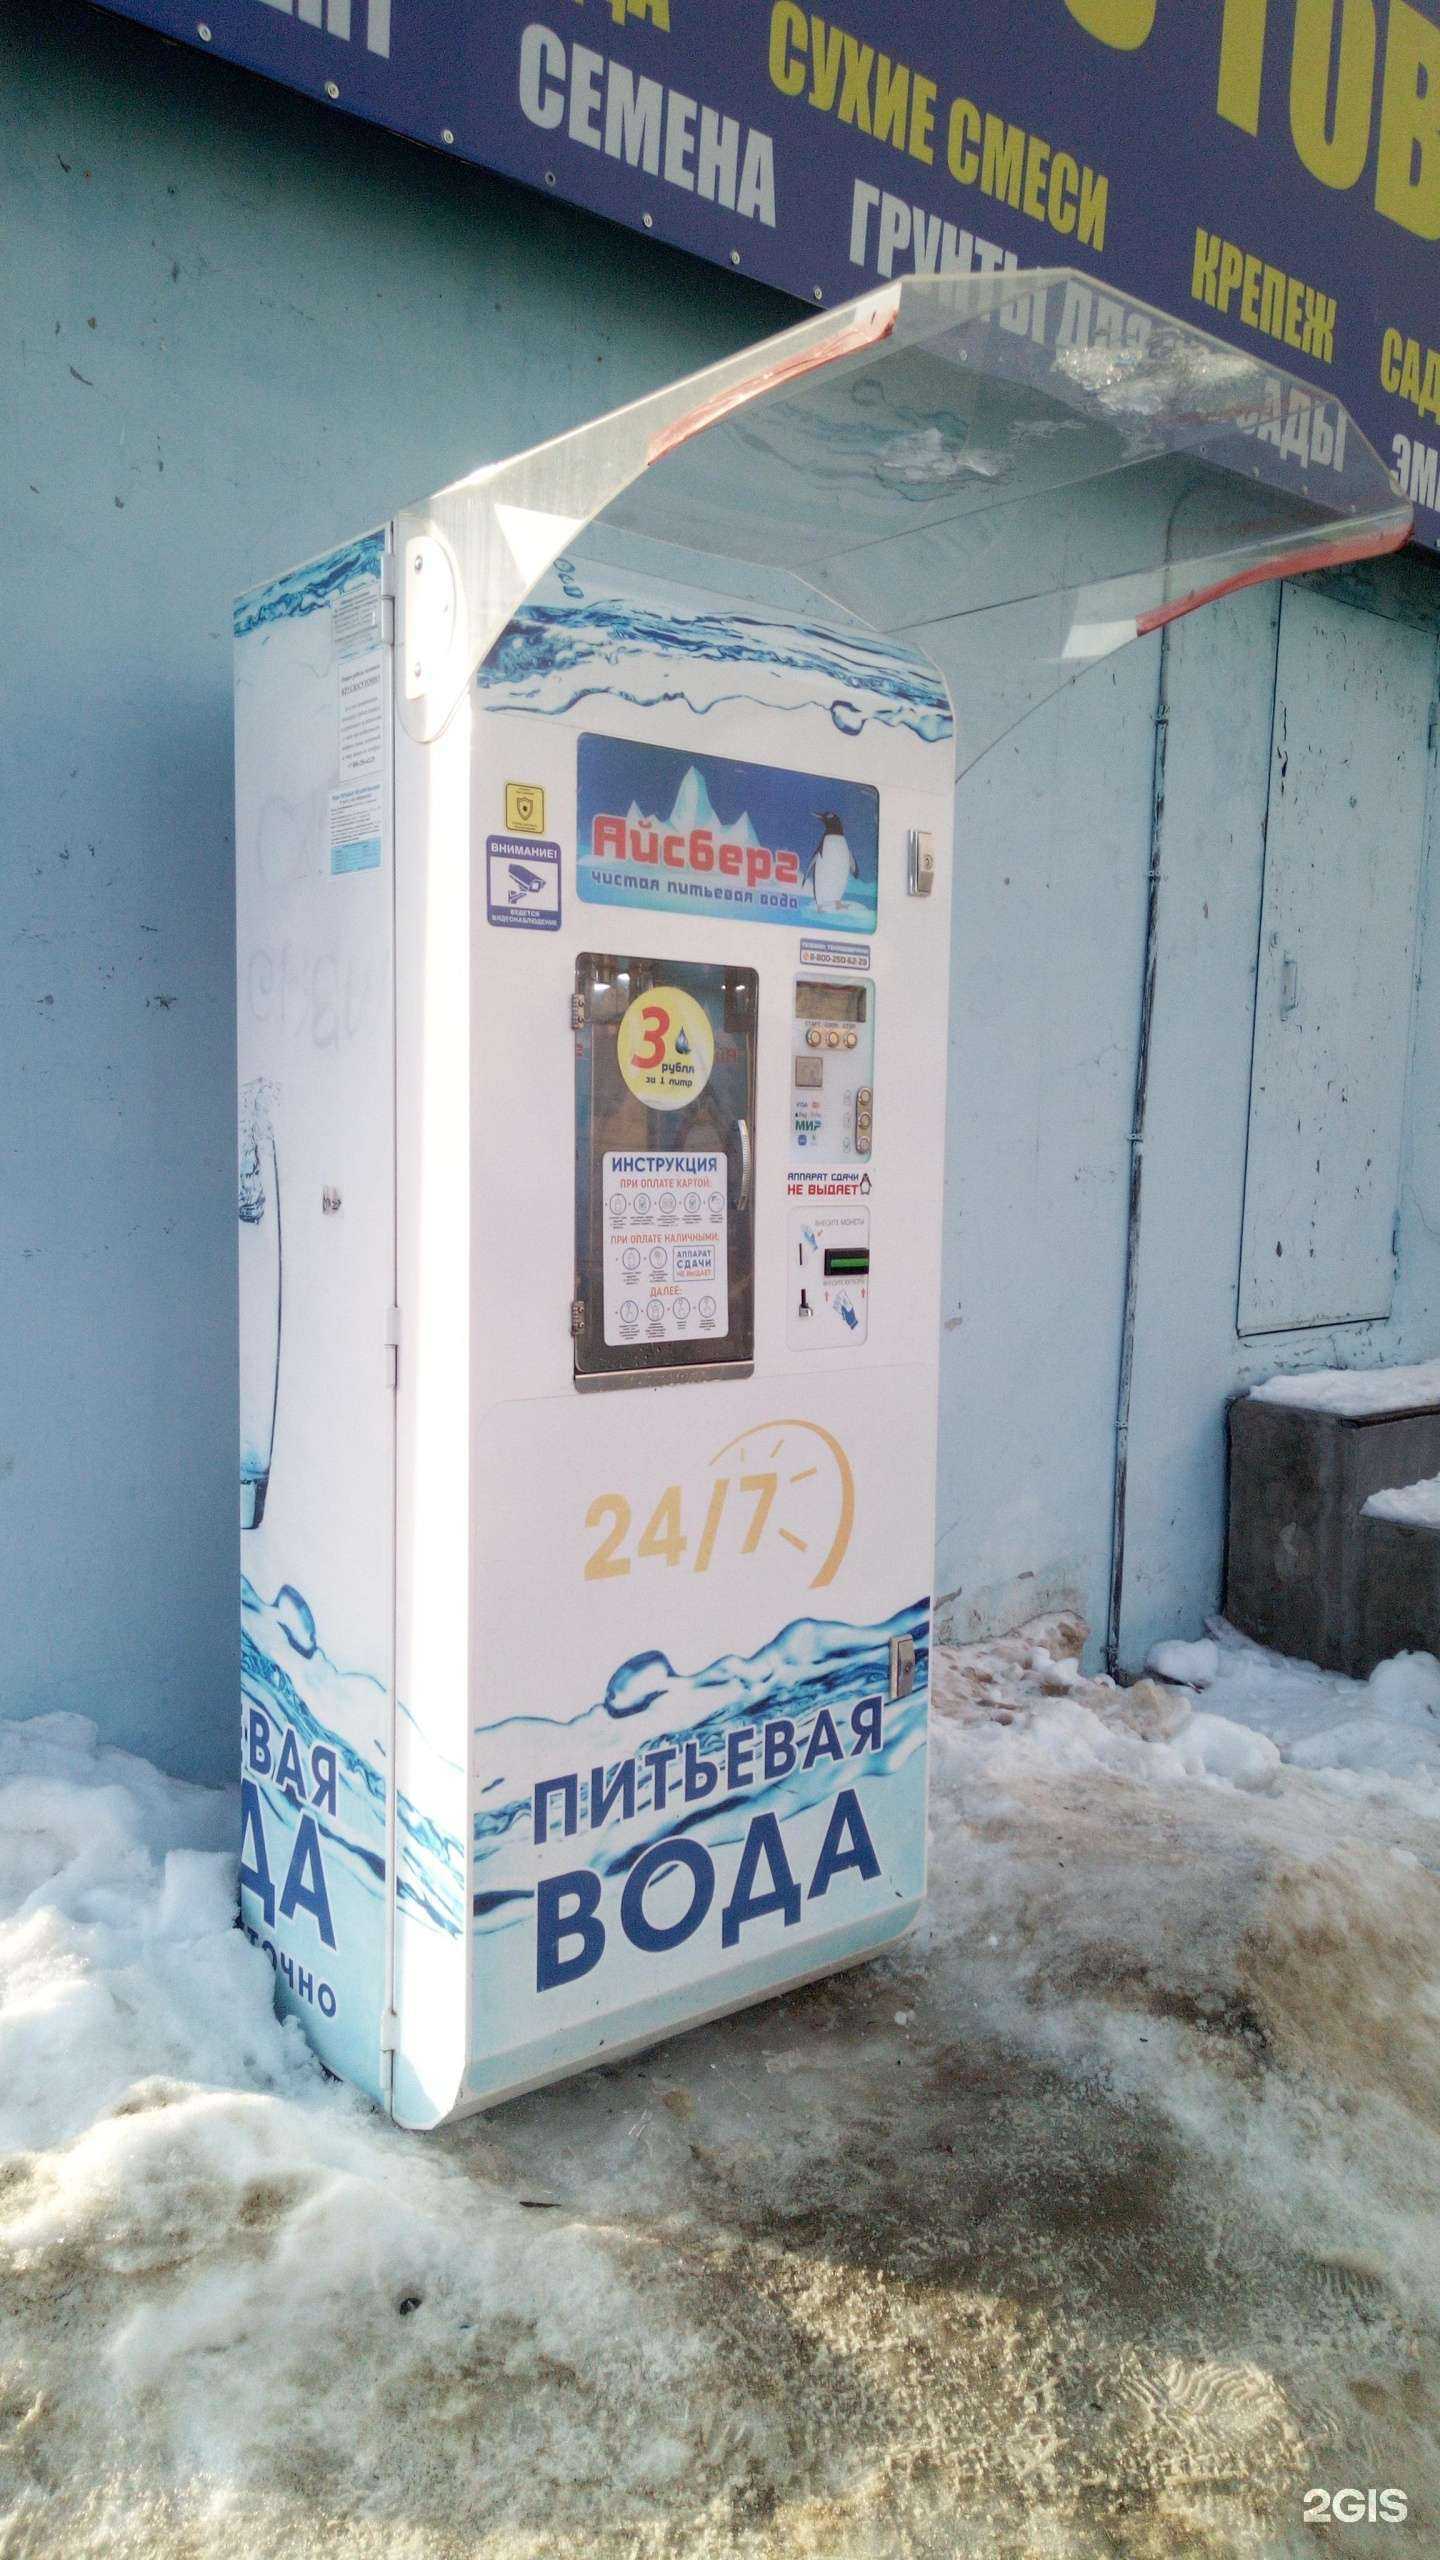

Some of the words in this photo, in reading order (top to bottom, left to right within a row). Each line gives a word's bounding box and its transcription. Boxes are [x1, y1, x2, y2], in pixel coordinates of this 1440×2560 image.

[519, 23, 777, 228] СЕМЕНА
[769, 0, 937, 166] СУХИЕ
[947, 97, 1109, 253] СМЕСИ
[1191, 226, 1338, 365] КРЕПЕЖ
[490, 842, 558, 859] ВНИМАНИЕ!
[593, 813, 800, 888] Айсберг
[592, 870, 660, 891] чистая
[667, 880, 753, 904] питьевая
[759, 892, 799, 909] вода
[630, 1006, 671, 1069] 3
[660, 1076, 665, 1085] 1
[795, 1119, 822, 1131] МИР
[611, 1156, 718, 1174] ИНСТРУКЦИЯ
[620, 1178, 638, 1189] ПРИ
[641, 1178, 673, 1189] ОПЛАТЕ
[787, 1173, 827, 1182] АППАРАТ
[831, 1173, 859, 1182] СДАЧИ
[787, 1184, 804, 1196] НЕ
[808, 1184, 860, 1196] ВЫДАЕТ
[610, 1235, 628, 1245] ПРИ
[630, 1234, 661, 1245] ОПЛАТЕ
[677, 1250, 712, 1258] АППАРАТ
[676, 1259, 712, 1270] СДАЧИ
[583, 1472, 778, 1582] 24/7
[533, 1695, 883, 1845] ПИТЬЕВАЯ
[536, 1788, 883, 1993] ВОДА
